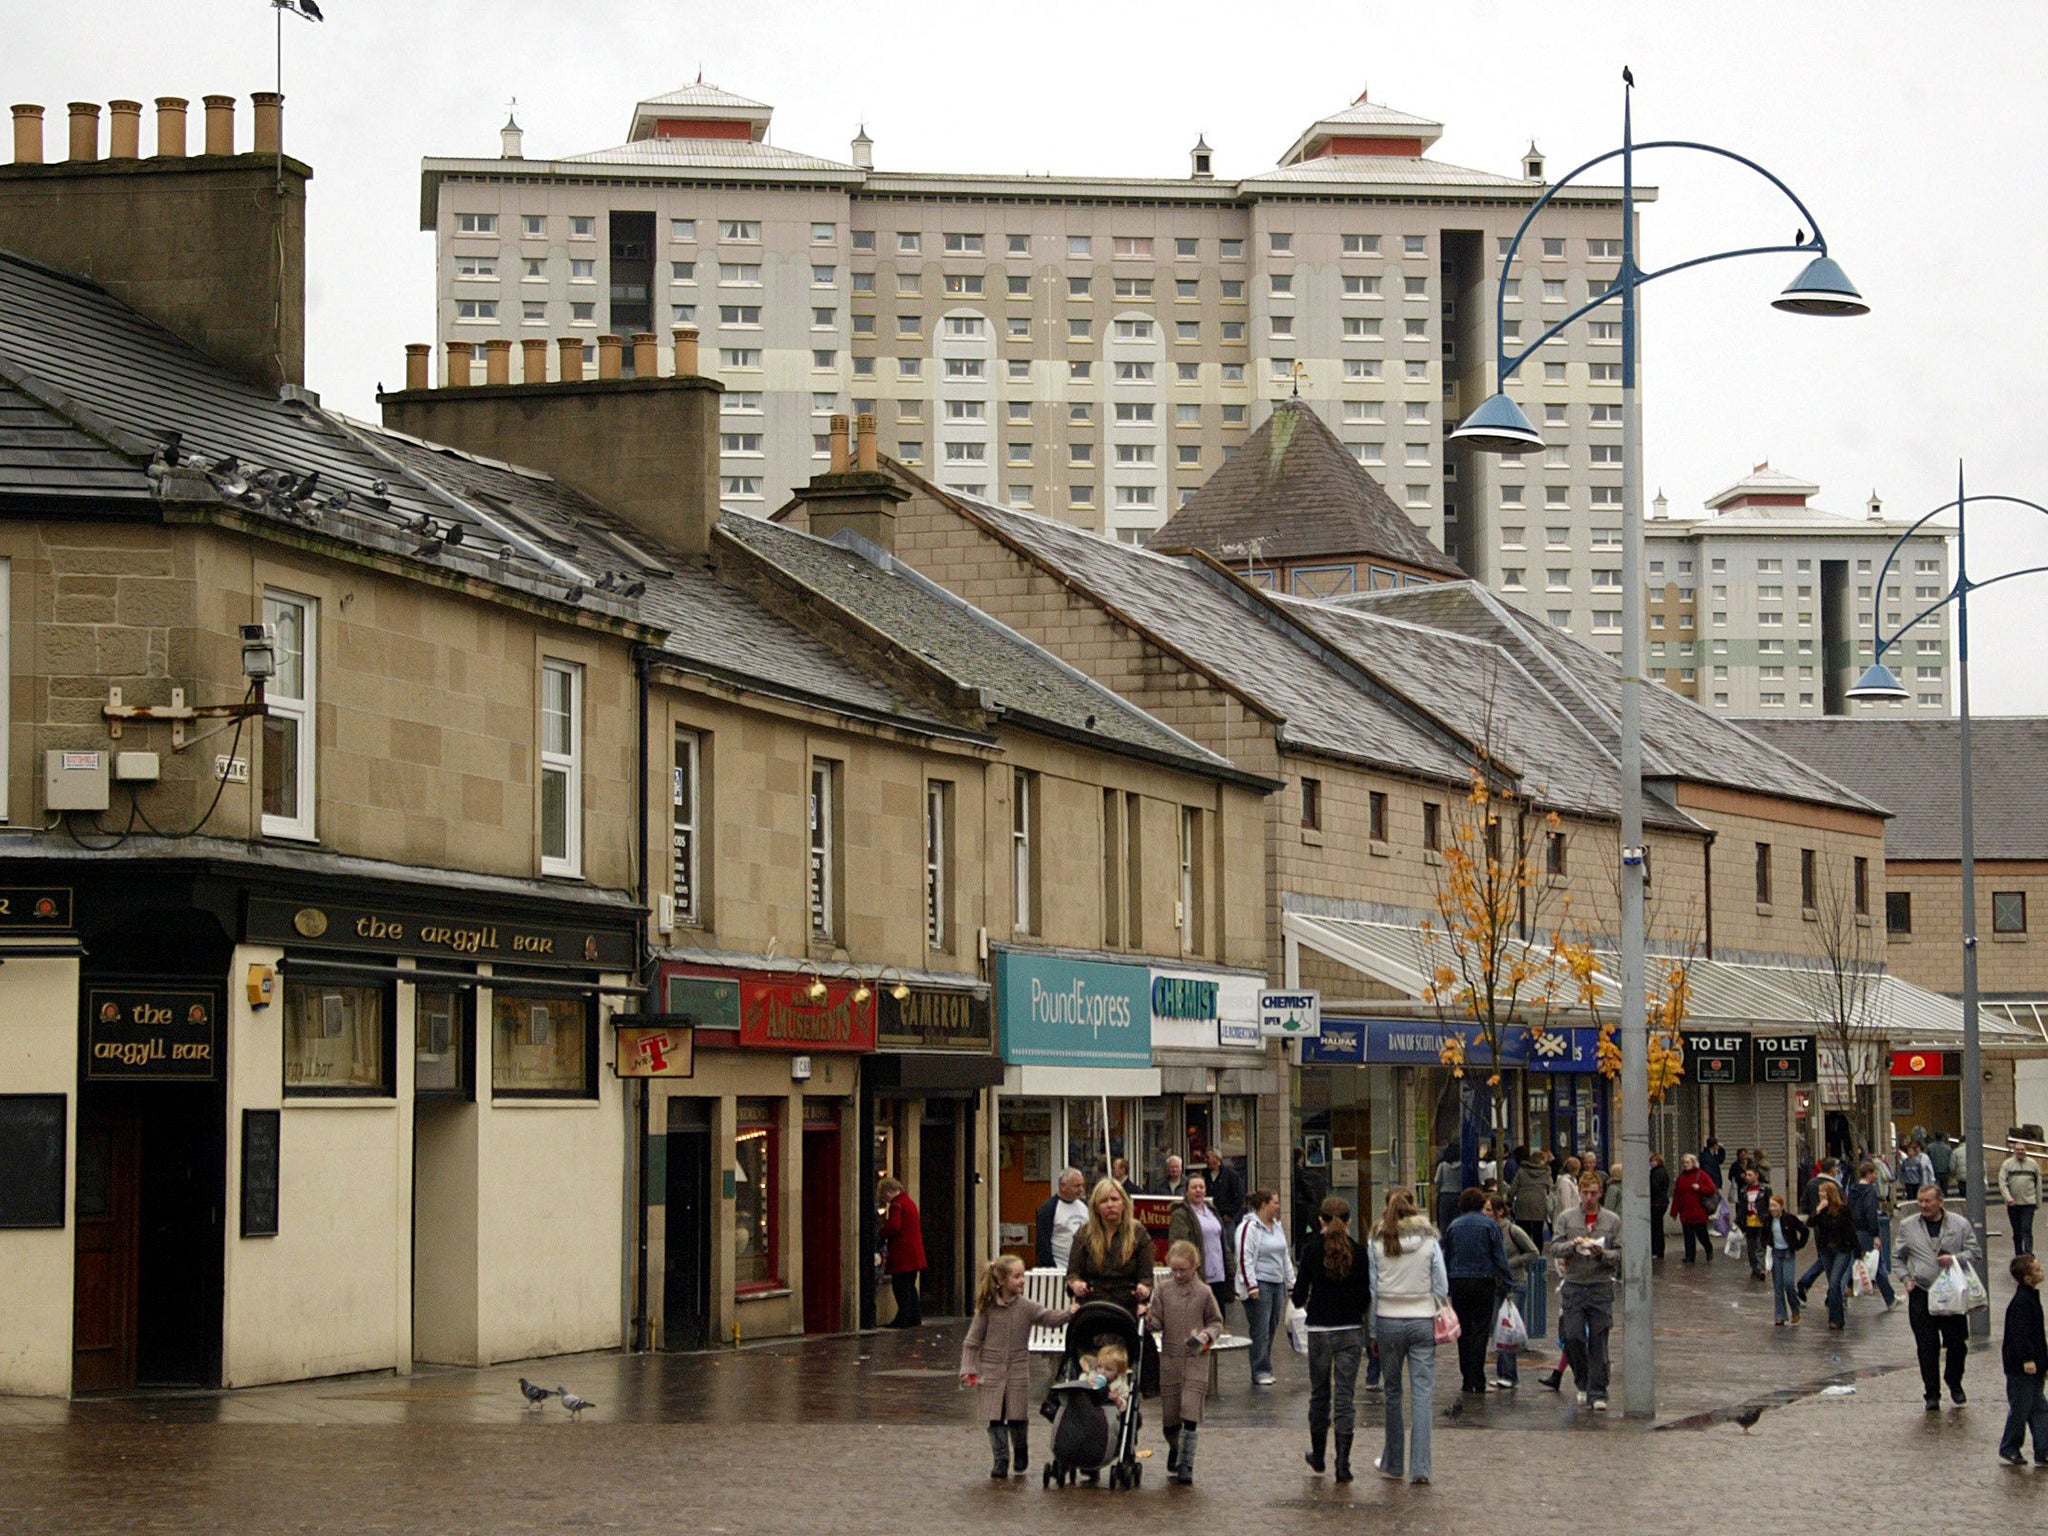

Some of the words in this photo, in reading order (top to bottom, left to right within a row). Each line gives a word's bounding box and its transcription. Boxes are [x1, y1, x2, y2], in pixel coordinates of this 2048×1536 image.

[356, 917, 403, 939] the
[1152, 976, 1219, 1020] CHEMIST
[1261, 996, 1314, 1009] CHEMIST
[132, 1003, 172, 1025] the
[900, 993, 970, 1028] CAMERON
[1031, 977, 1131, 1040] PoundExpress
[1264, 1016, 1281, 1025] OPEN
[1320, 1037, 1357, 1047] HALIFAX
[1388, 1033, 1406, 1051] BANK
[1406, 1034, 1414, 1051] OF
[1415, 1034, 1448, 1052] SCOTLAN
[1690, 1037, 1711, 1051] TO
[1715, 1038, 1743, 1051] LET
[1757, 1039, 1778, 1051] TO
[1781, 1039, 1808, 1052] LET
